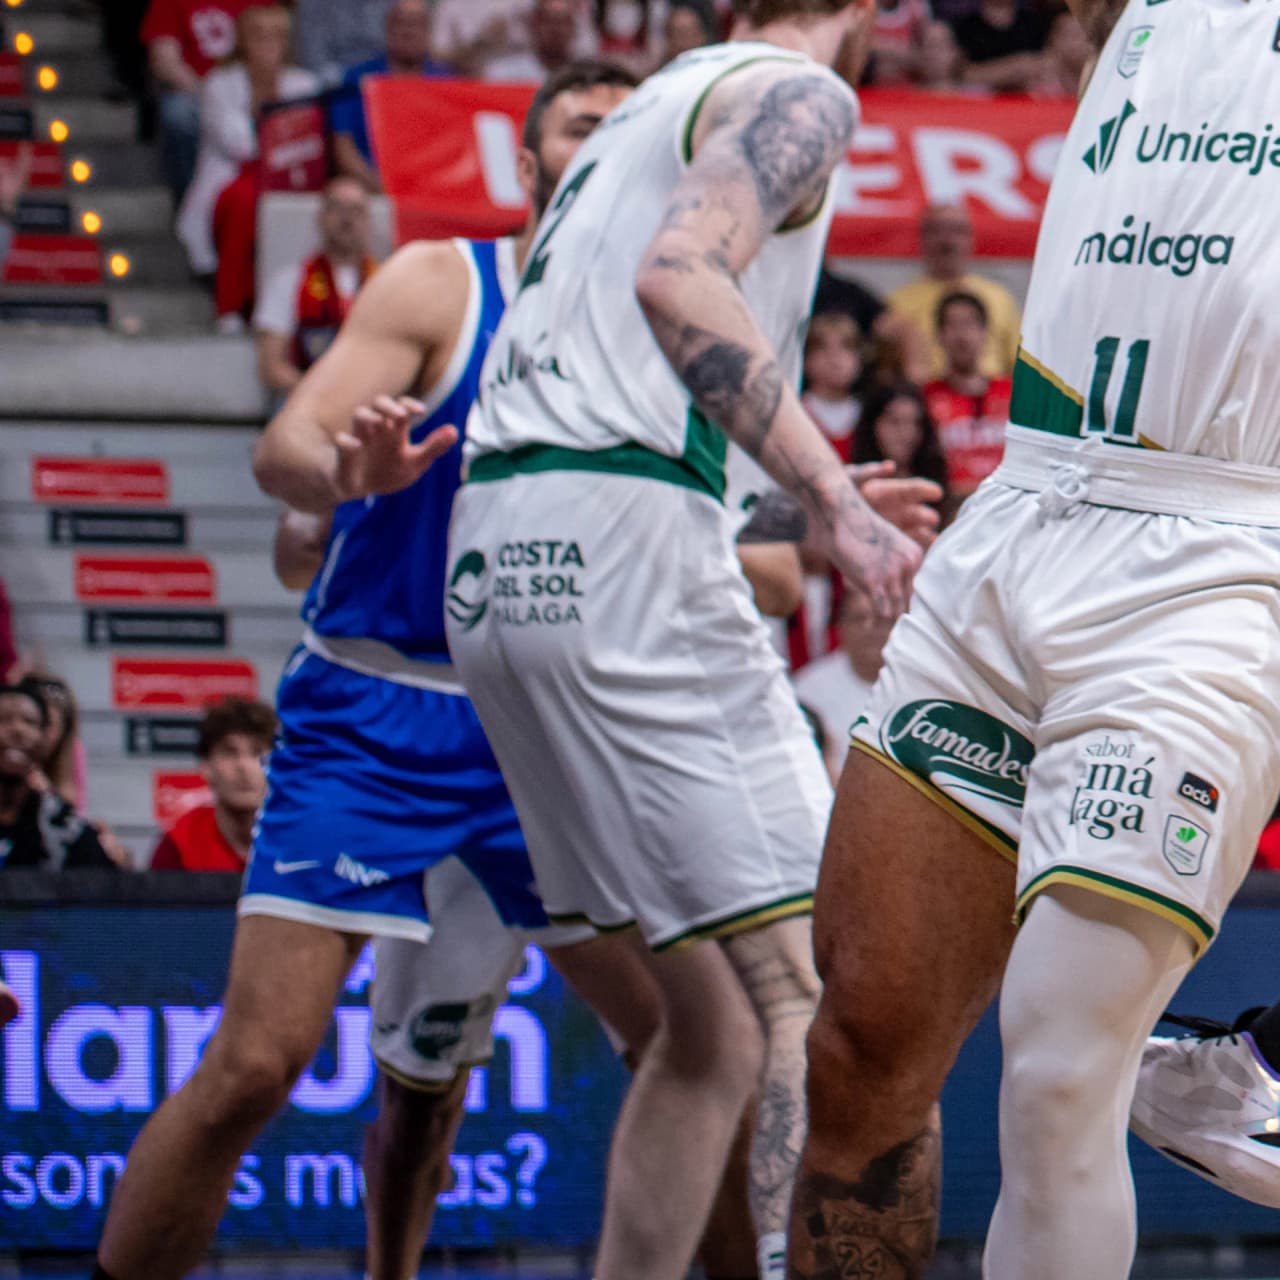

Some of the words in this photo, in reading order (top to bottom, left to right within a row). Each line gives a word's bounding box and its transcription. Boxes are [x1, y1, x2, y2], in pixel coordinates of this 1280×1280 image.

[1074, 214, 1236, 277] málaga
[1088, 336, 1151, 442] 11
[498, 540, 586, 568] COSTA
[529, 574, 584, 597] SOL
[1181, 783, 1211, 806] acb
